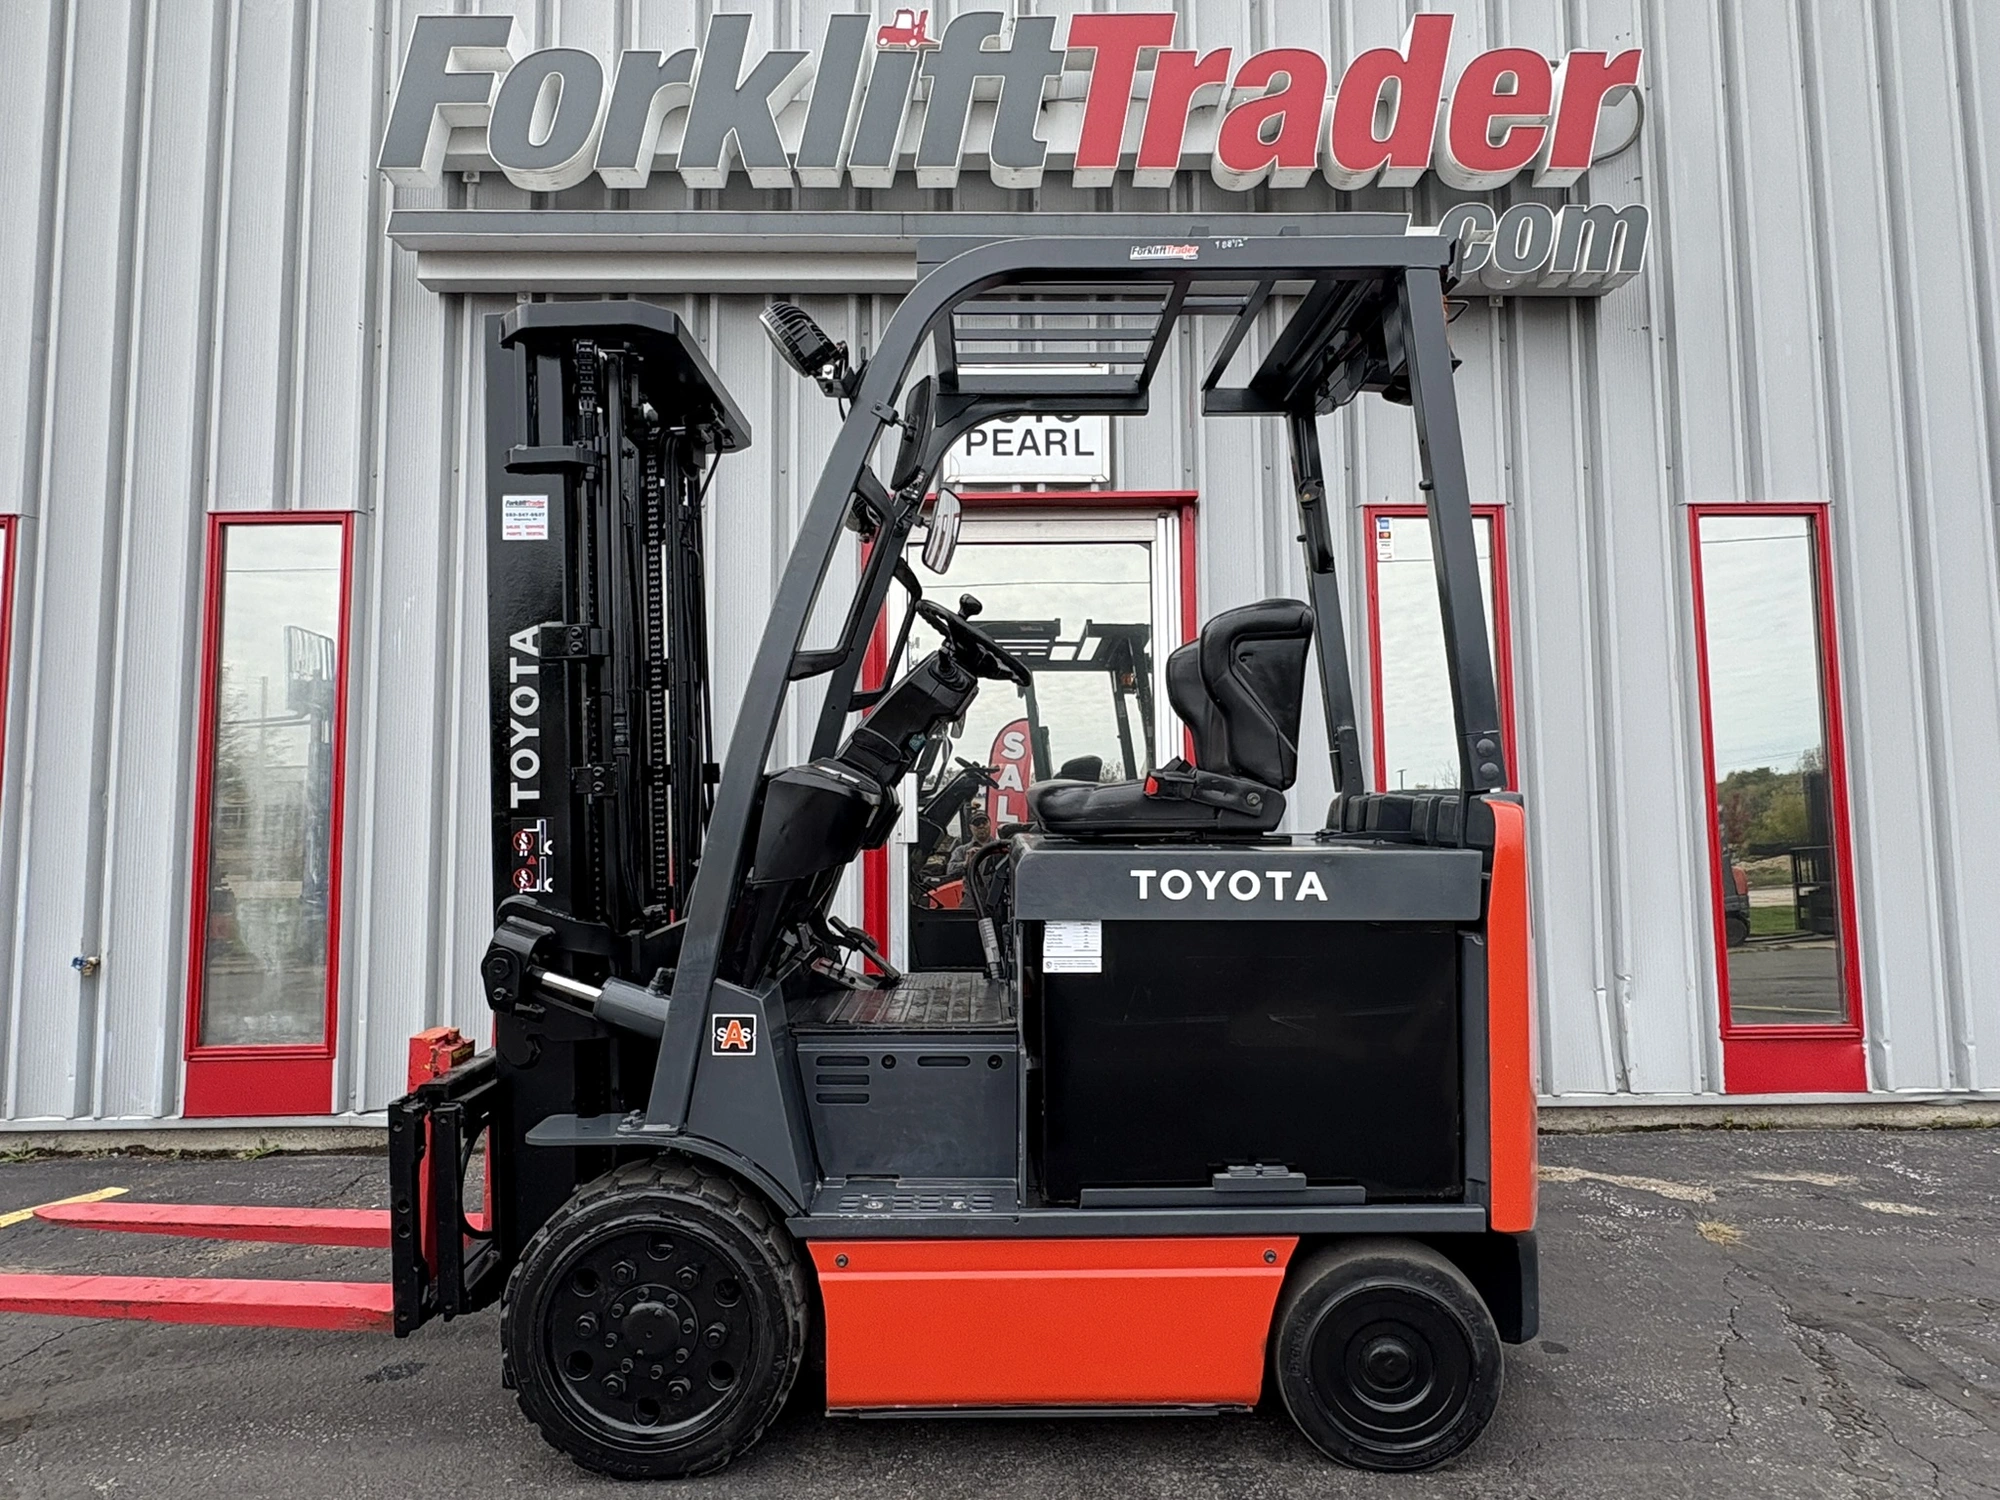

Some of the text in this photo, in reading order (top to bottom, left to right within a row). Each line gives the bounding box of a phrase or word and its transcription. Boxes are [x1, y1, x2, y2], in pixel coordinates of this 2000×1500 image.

[965, 428, 1095, 457] PEARL
[509, 624, 541, 809] TOYOTA
[1129, 868, 1330, 902] TOYOTA
[716, 1019, 752, 1050] SAS
